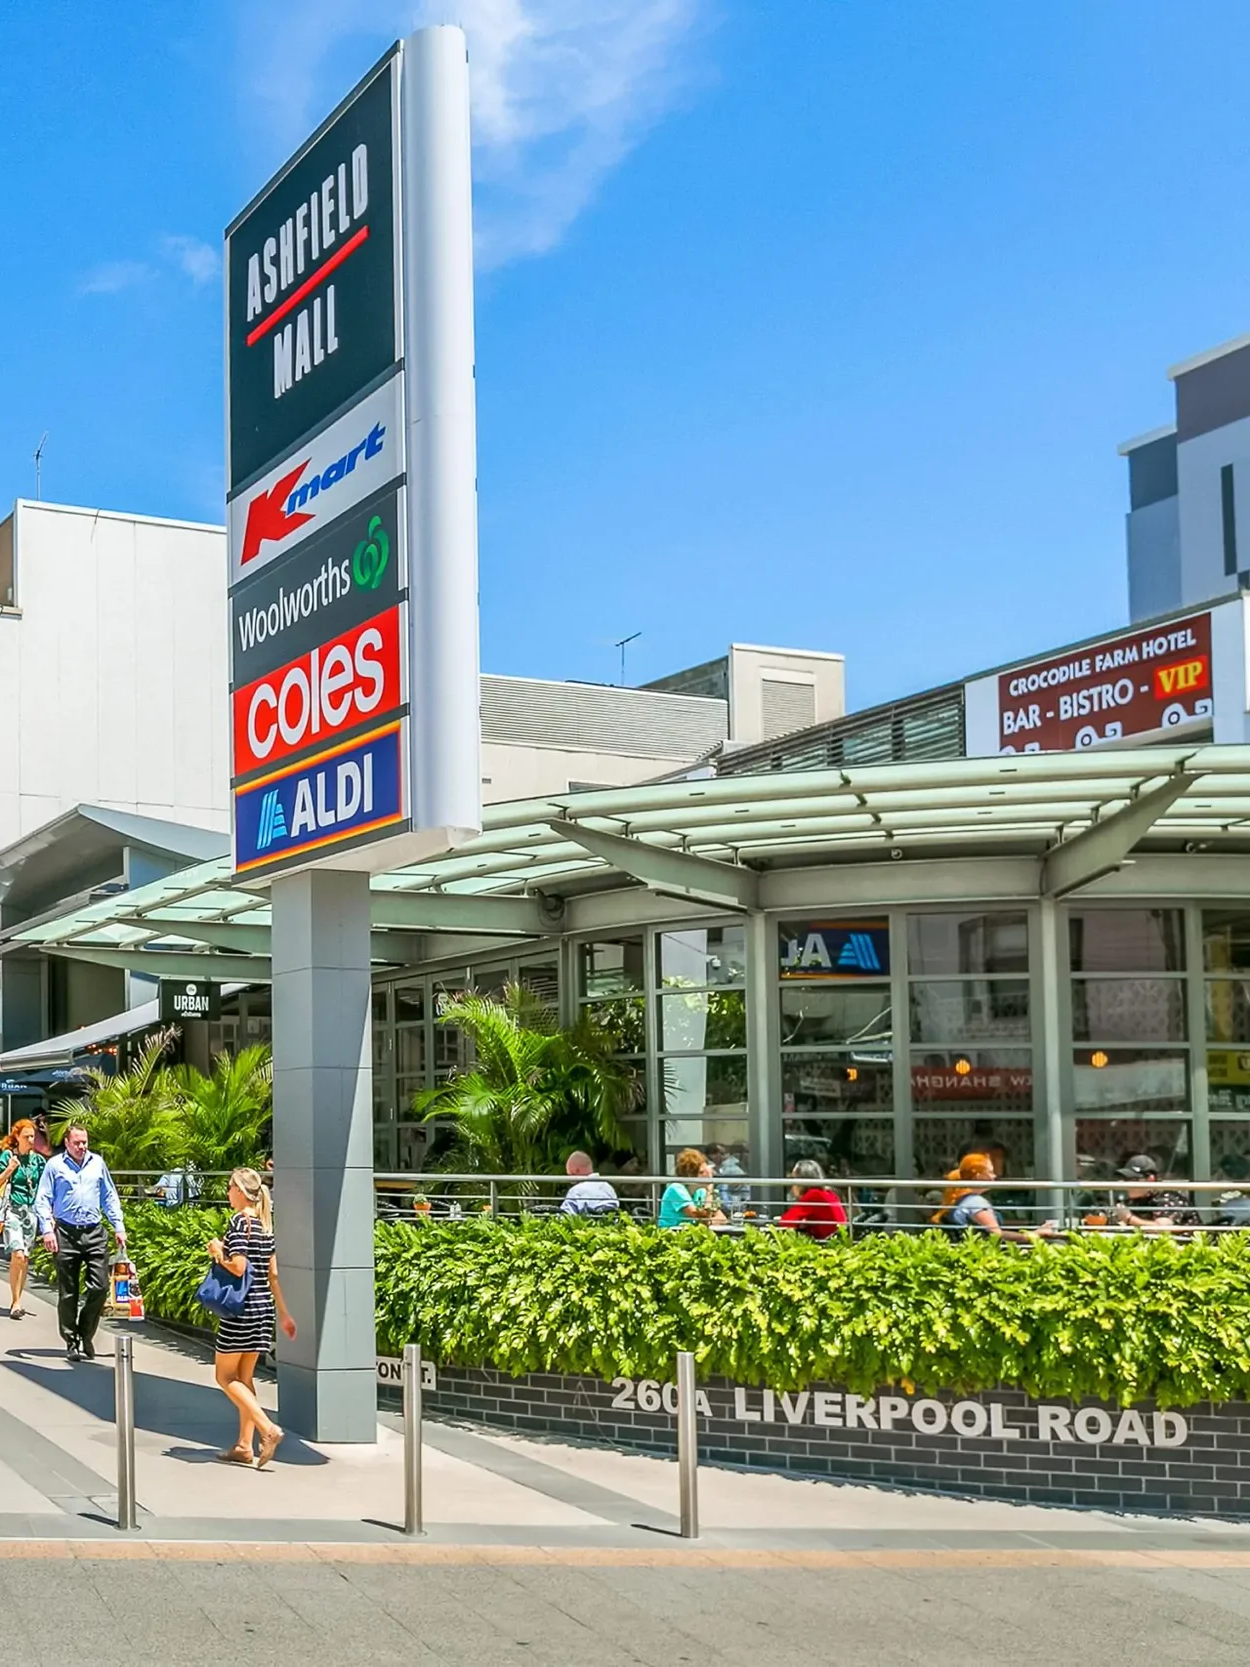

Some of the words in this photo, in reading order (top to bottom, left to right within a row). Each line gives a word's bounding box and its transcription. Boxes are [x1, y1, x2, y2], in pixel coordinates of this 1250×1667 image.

[247, 143, 369, 322] ASHFIELD
[273, 285, 338, 399] MALL
[241, 421, 387, 566] Kmart
[238, 557, 351, 652] Woolworths
[247, 628, 385, 759] coles
[1003, 704, 1042, 736] BAR
[1059, 678, 1134, 721] BISTRO
[1158, 661, 1203, 694] VIP
[1008, 658, 1091, 697] CROCODILE
[1095, 645, 1139, 672] FARM
[1142, 628, 1196, 660] HOTEL
[290, 753, 373, 838] ALDI
[174, 995, 209, 1011] URBAN
[376, 1361, 401, 1380] ON
[734, 1387, 1020, 1439] LIVERPOOL
[1038, 1405, 1189, 1447] ROAD
